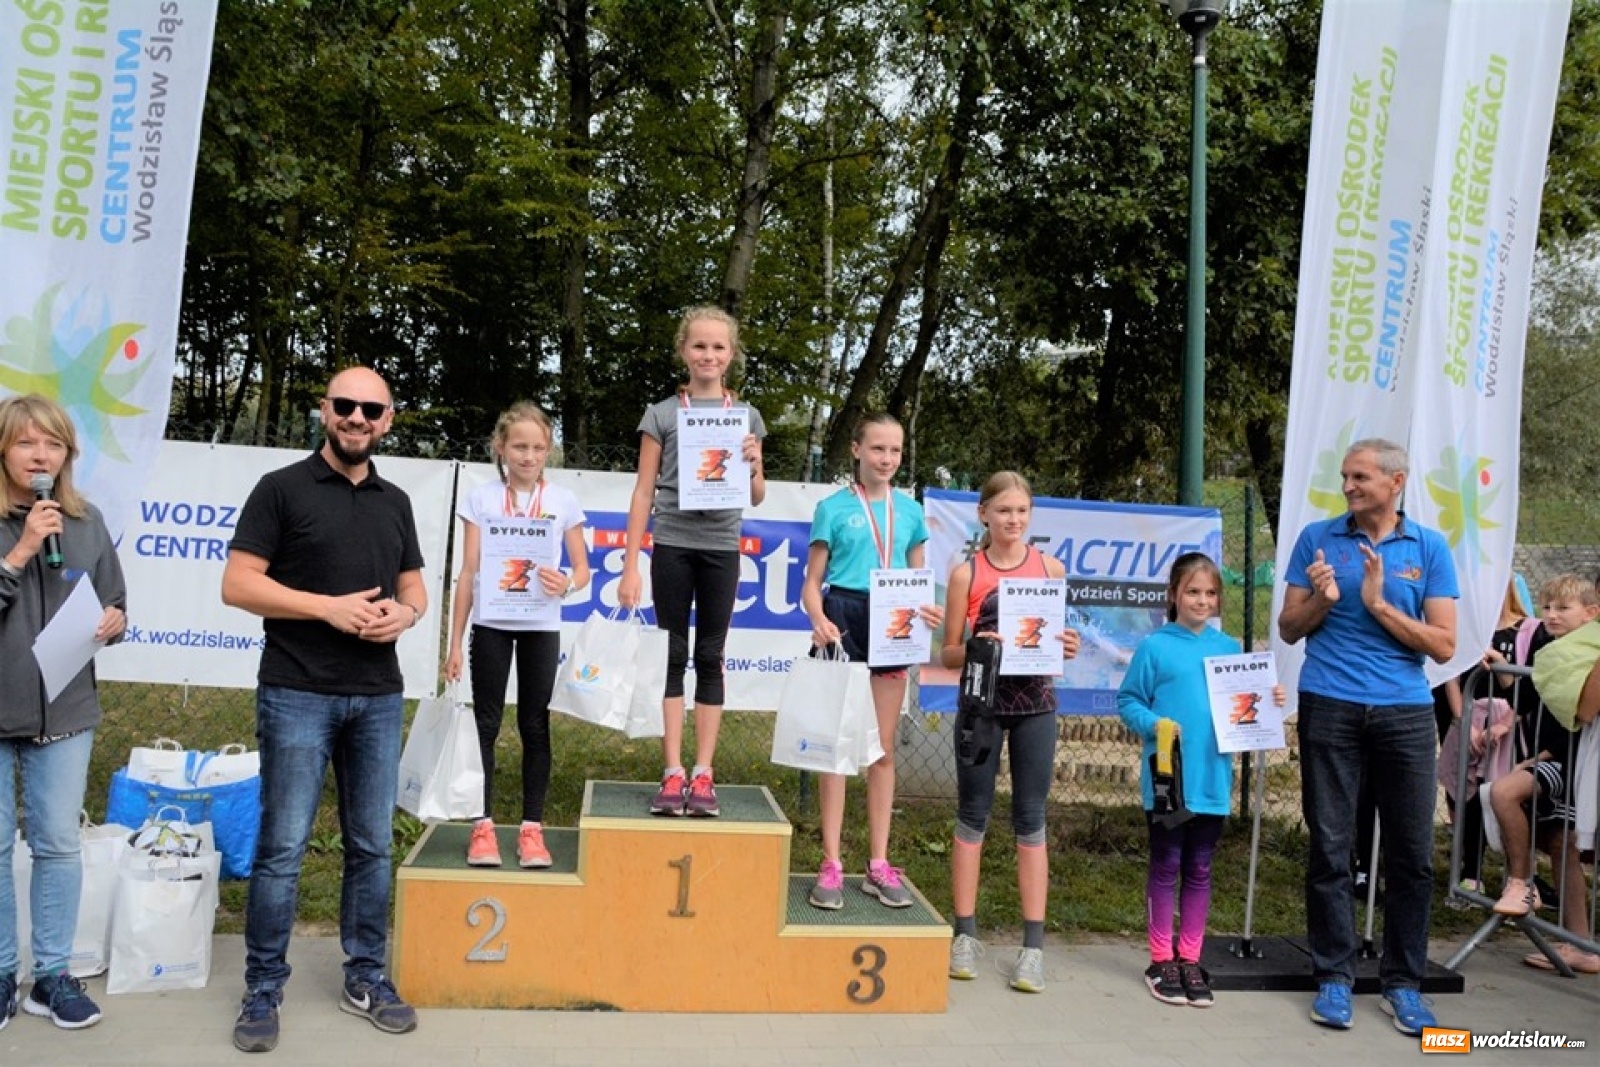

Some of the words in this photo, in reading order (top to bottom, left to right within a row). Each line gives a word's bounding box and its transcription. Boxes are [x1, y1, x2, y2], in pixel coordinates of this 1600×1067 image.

[16, 0, 65, 57] OŚ
[75, 0, 109, 33] R
[71, 44, 108, 59] I
[2, 68, 56, 231] MIEJSKI
[50, 72, 102, 241] SPORTU
[99, 29, 142, 245] CENTRUM
[132, 72, 170, 244] Wodzisław
[1335, 71, 1372, 238] OŚRODEK
[1464, 53, 1508, 227] REKREACJI
[1342, 249, 1377, 384] SPORTU
[1373, 219, 1413, 391] CENTRUM
[1450, 254, 1480, 388] SPORTU
[1484, 271, 1508, 399] Wodzisław
[687, 418, 743, 426] DYPLOM
[141, 500, 237, 528] WODZ
[490, 527, 546, 537] DYPLOM
[135, 534, 231, 561] CENTR
[878, 578, 928, 587] DYPLOM
[1007, 587, 1059, 596] DYPLOM
[1214, 661, 1269, 674] DYPLOM
[667, 854, 696, 918] 1
[465, 897, 508, 963] 2
[846, 944, 888, 1004] 3
